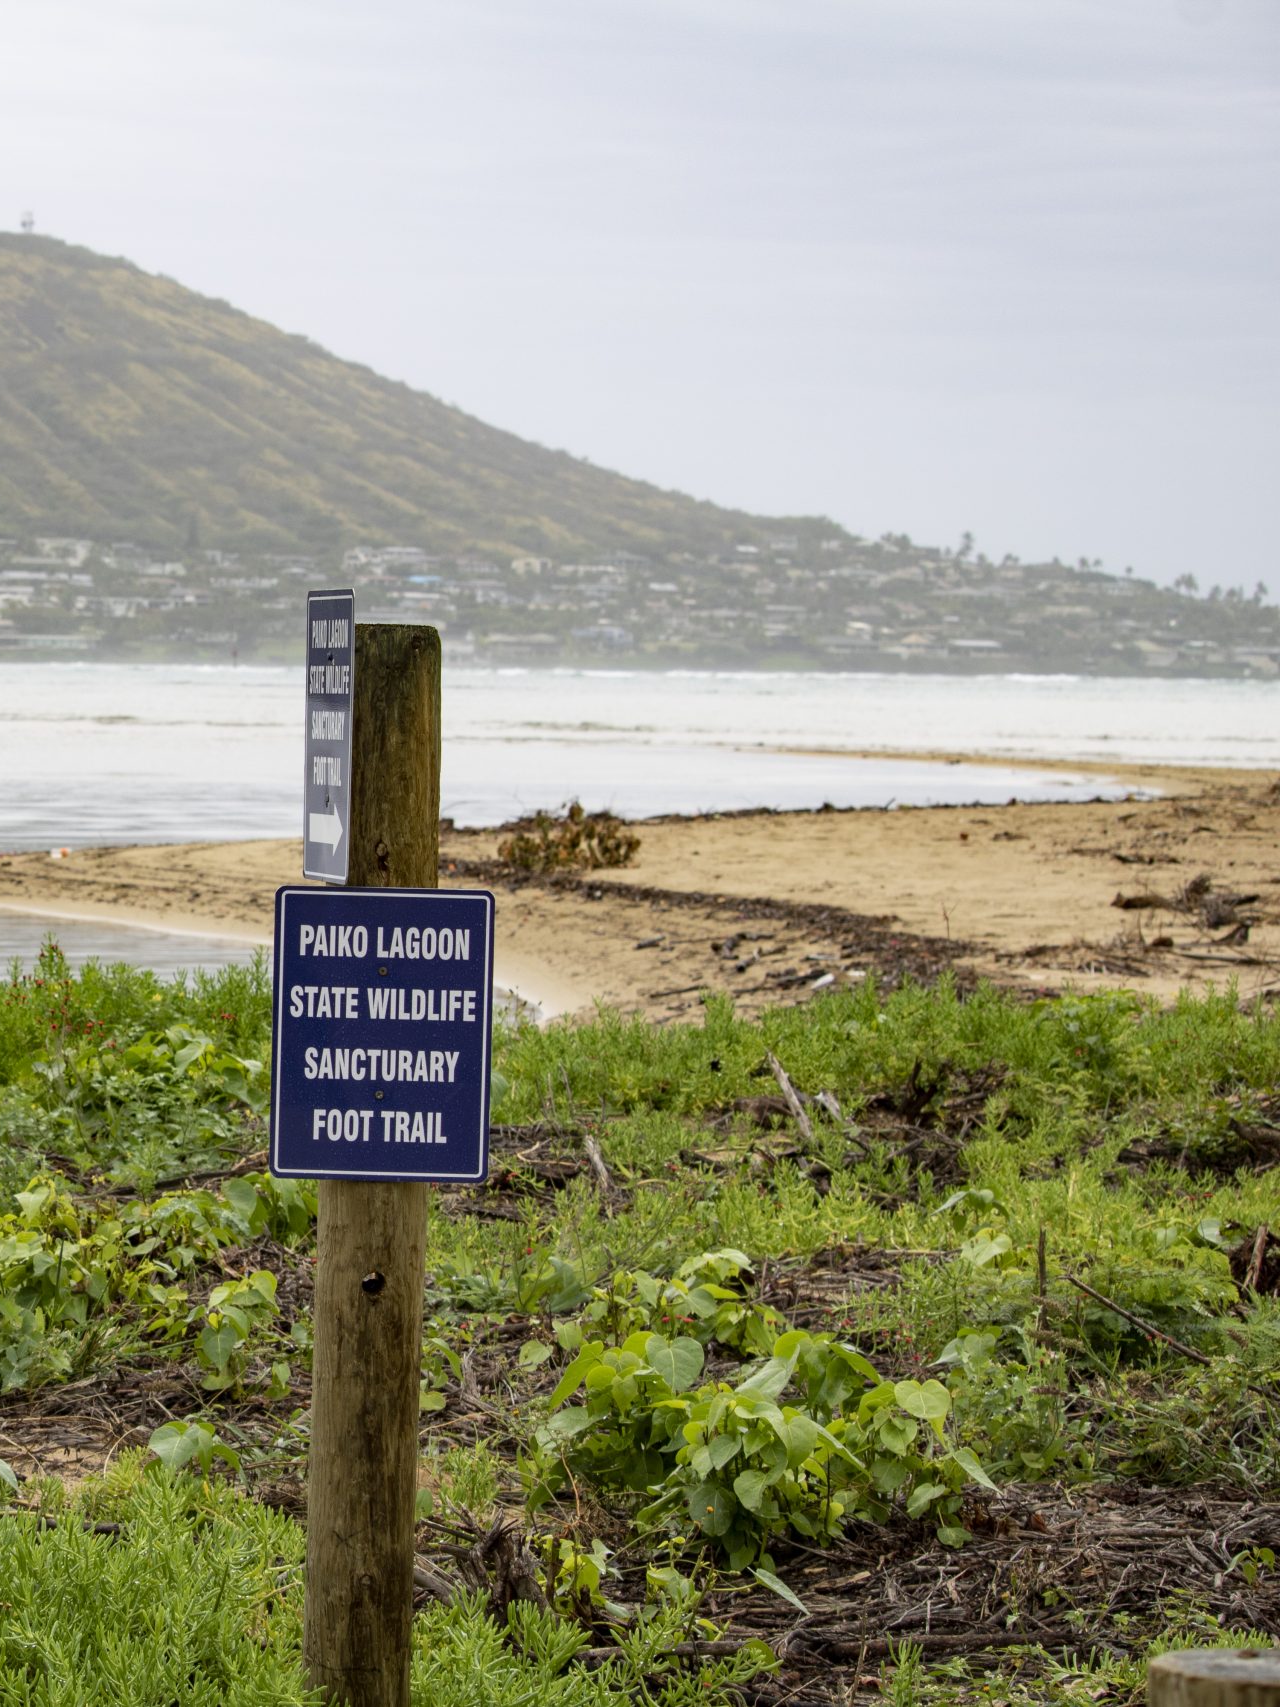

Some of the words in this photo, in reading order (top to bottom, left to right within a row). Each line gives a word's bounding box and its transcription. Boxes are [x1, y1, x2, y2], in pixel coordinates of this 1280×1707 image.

[312, 619, 327, 648] PAIKO
[328, 619, 349, 648] LAGOON
[310, 666, 324, 694] STATE
[325, 666, 349, 694] WILDLIFE
[314, 756, 326, 786] FOOT
[327, 757, 341, 787] TRAIL
[299, 924, 368, 958] PAIKO
[376, 926, 470, 961] LAGOON
[290, 985, 359, 1018] STATE
[367, 988, 477, 1022] WILDLIFE
[304, 1047, 460, 1083] SANCTURARY
[312, 1109, 374, 1142] FOOT
[381, 1110, 447, 1144] TRAIL
